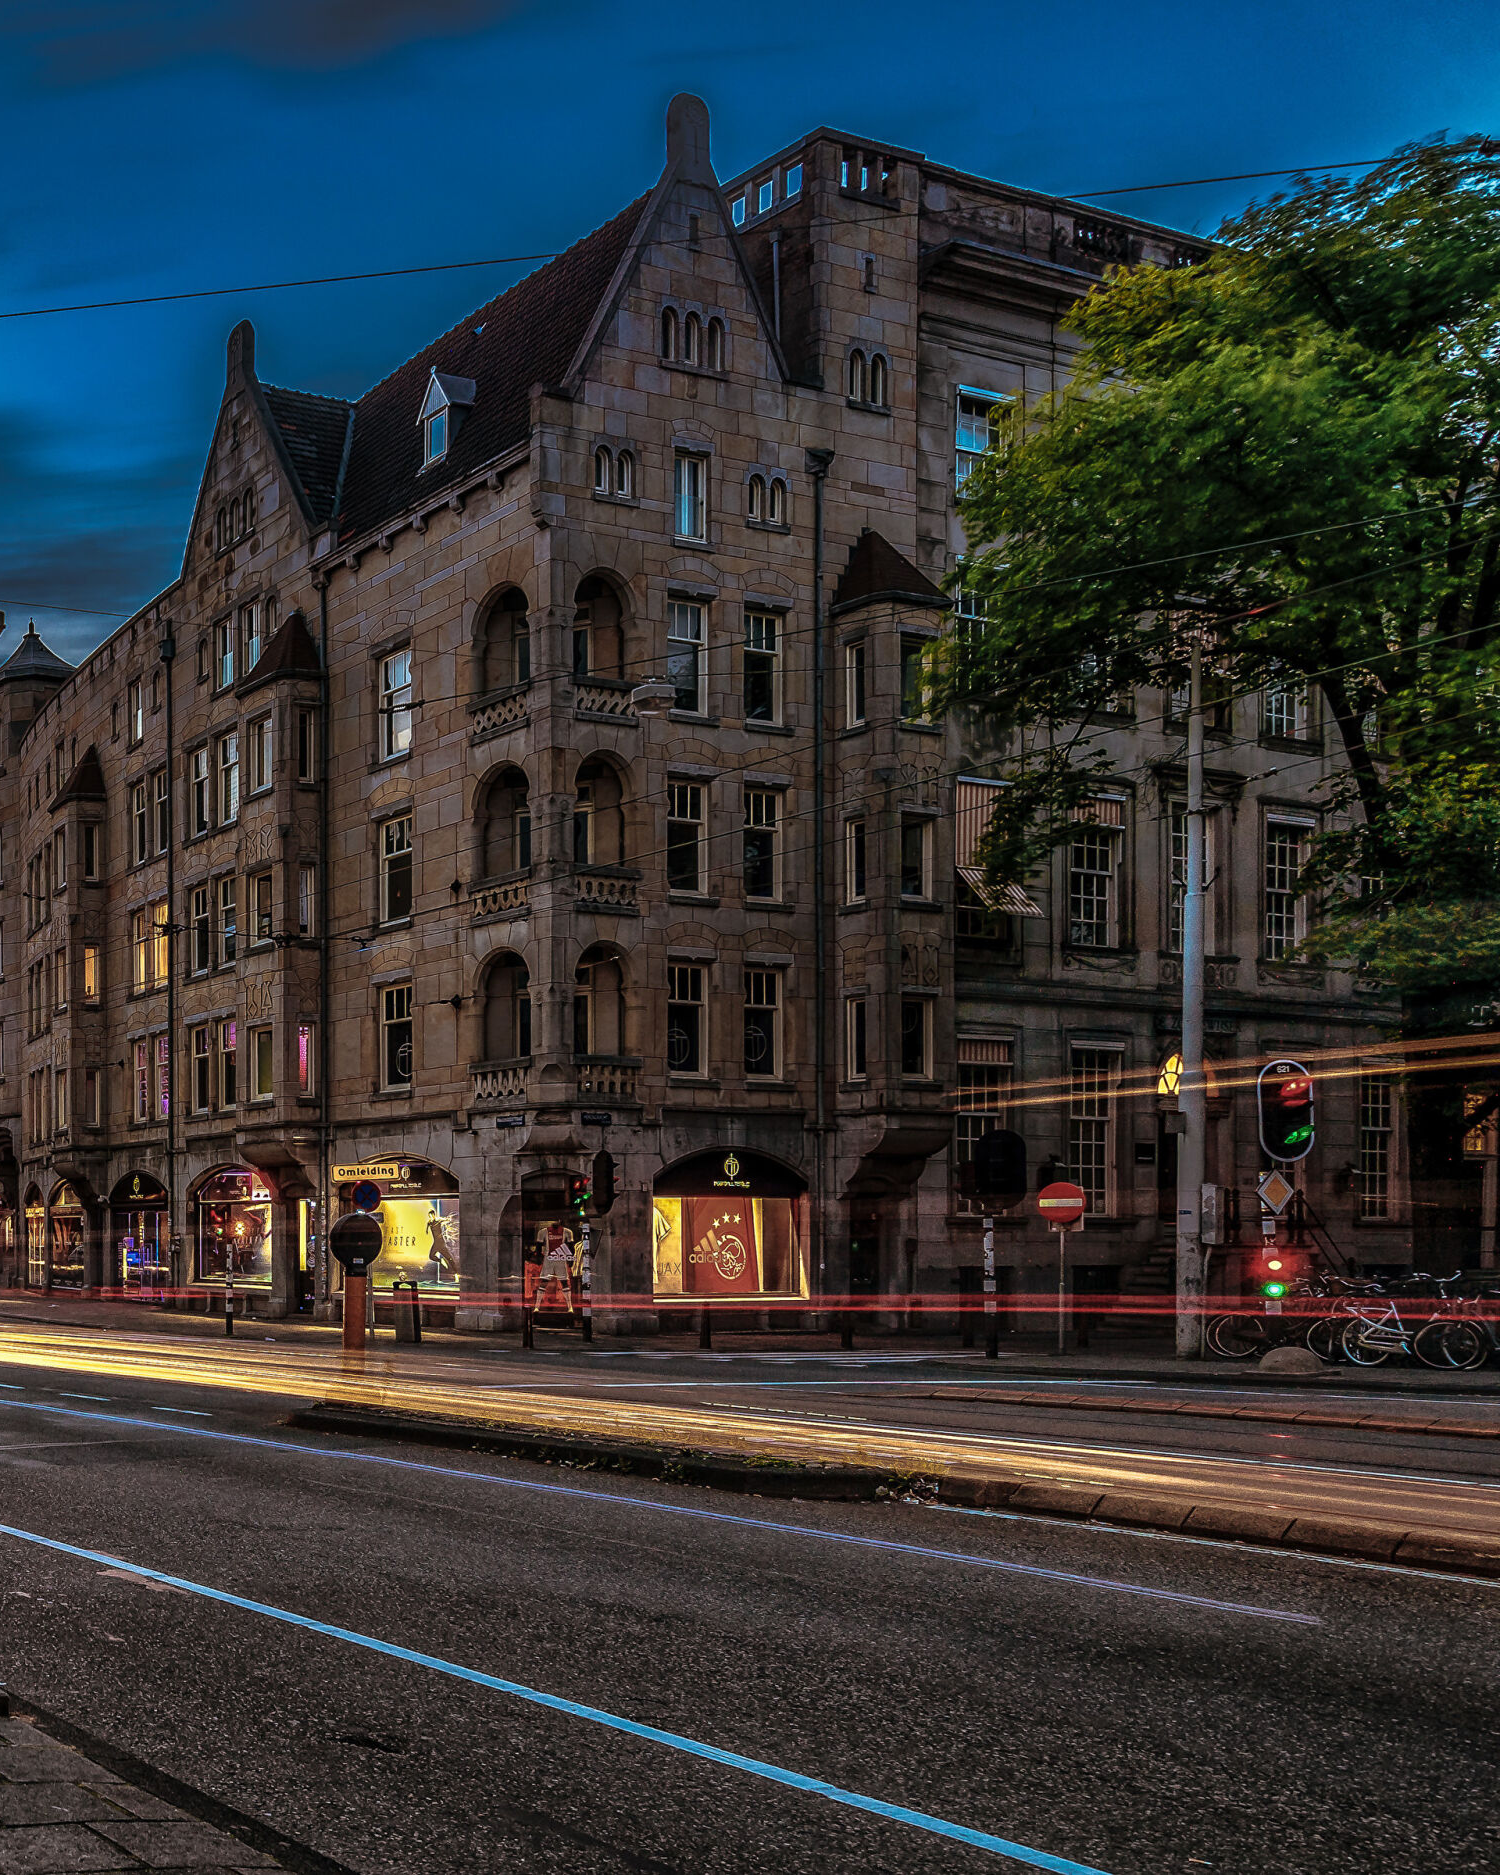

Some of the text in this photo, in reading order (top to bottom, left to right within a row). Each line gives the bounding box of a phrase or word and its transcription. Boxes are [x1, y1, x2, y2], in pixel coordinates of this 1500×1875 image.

[1276, 1065, 1290, 1073] 621
[338, 1166, 394, 1176] Omleiding
[386, 1236, 416, 1246] ASTER
